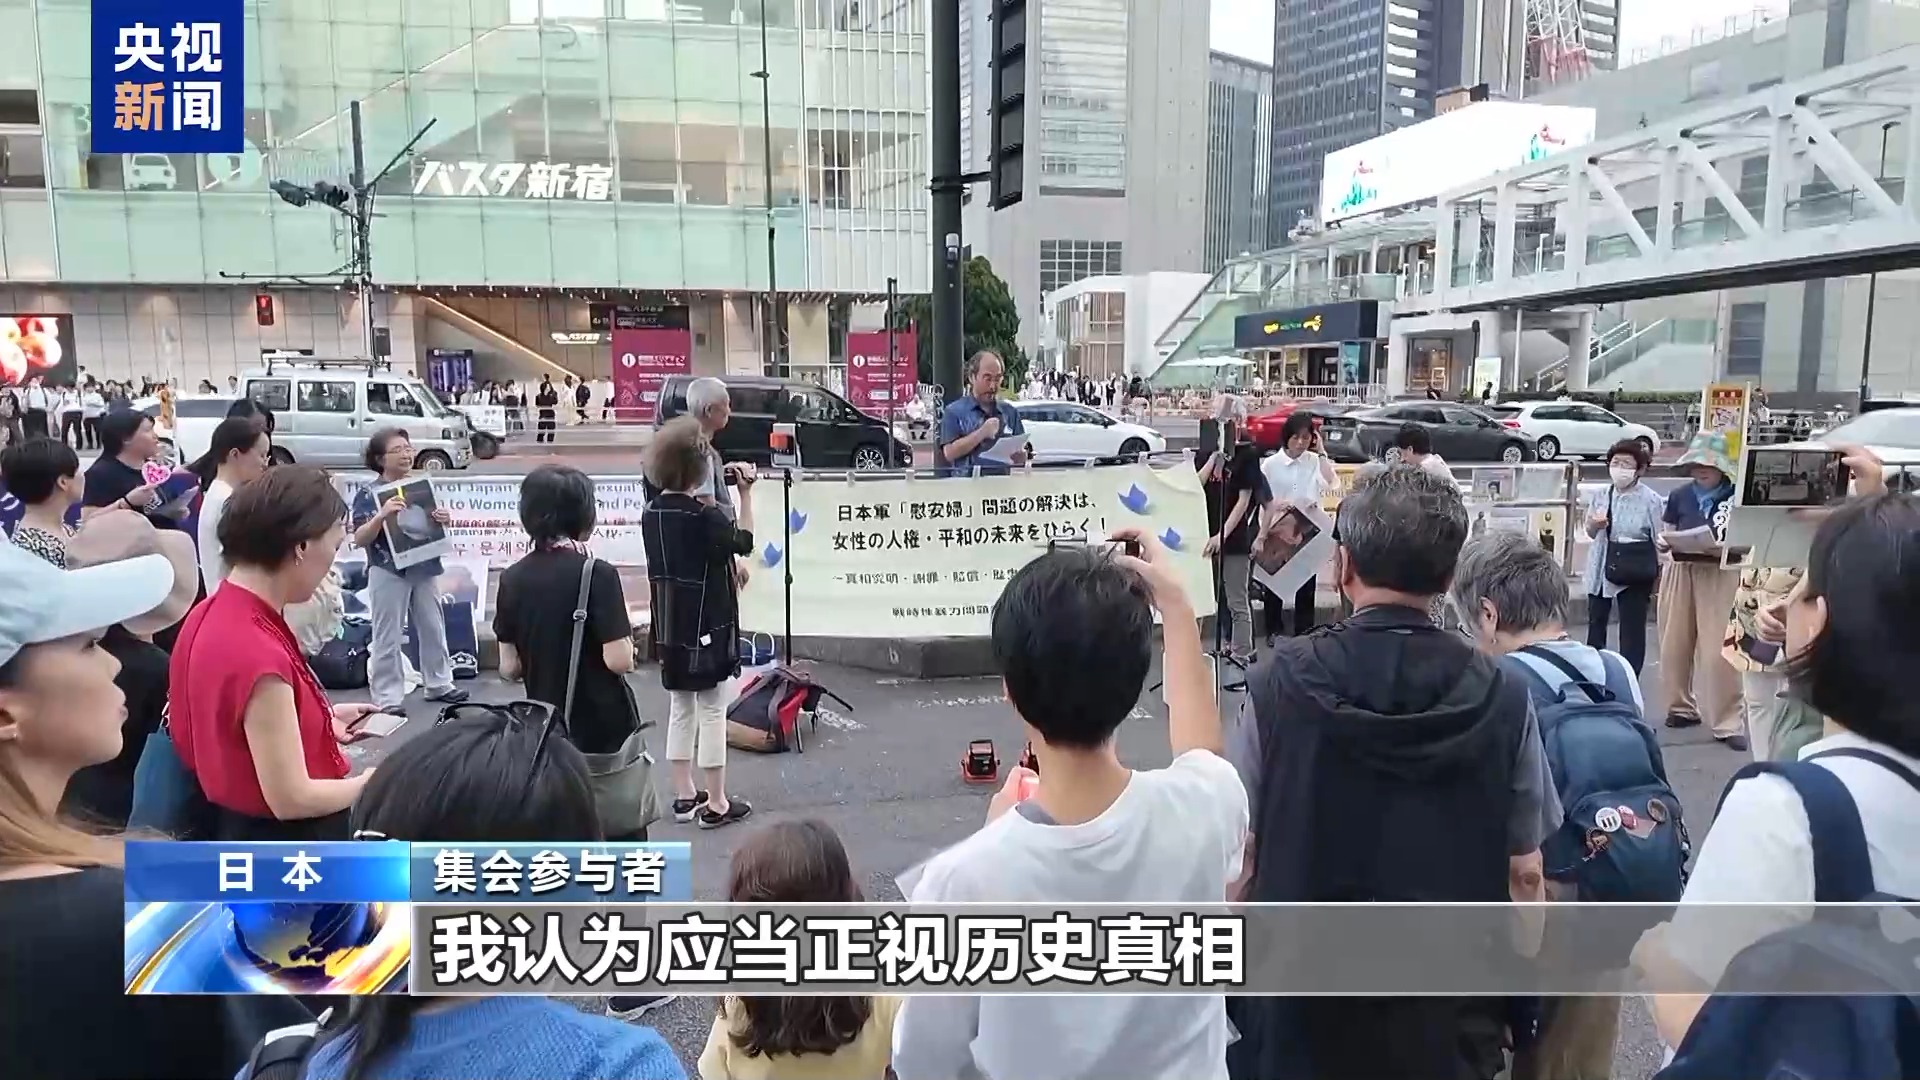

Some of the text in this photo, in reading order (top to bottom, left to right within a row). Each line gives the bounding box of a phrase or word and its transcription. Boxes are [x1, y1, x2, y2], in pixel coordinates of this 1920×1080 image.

[413, 157, 614, 200] バスタ新宿
[596, 483, 636, 492] exual
[449, 499, 465, 510] to
[469, 498, 519, 510] Wome
[838, 493, 1097, 522] 日本軍「慰安婦」問題の解決は、
